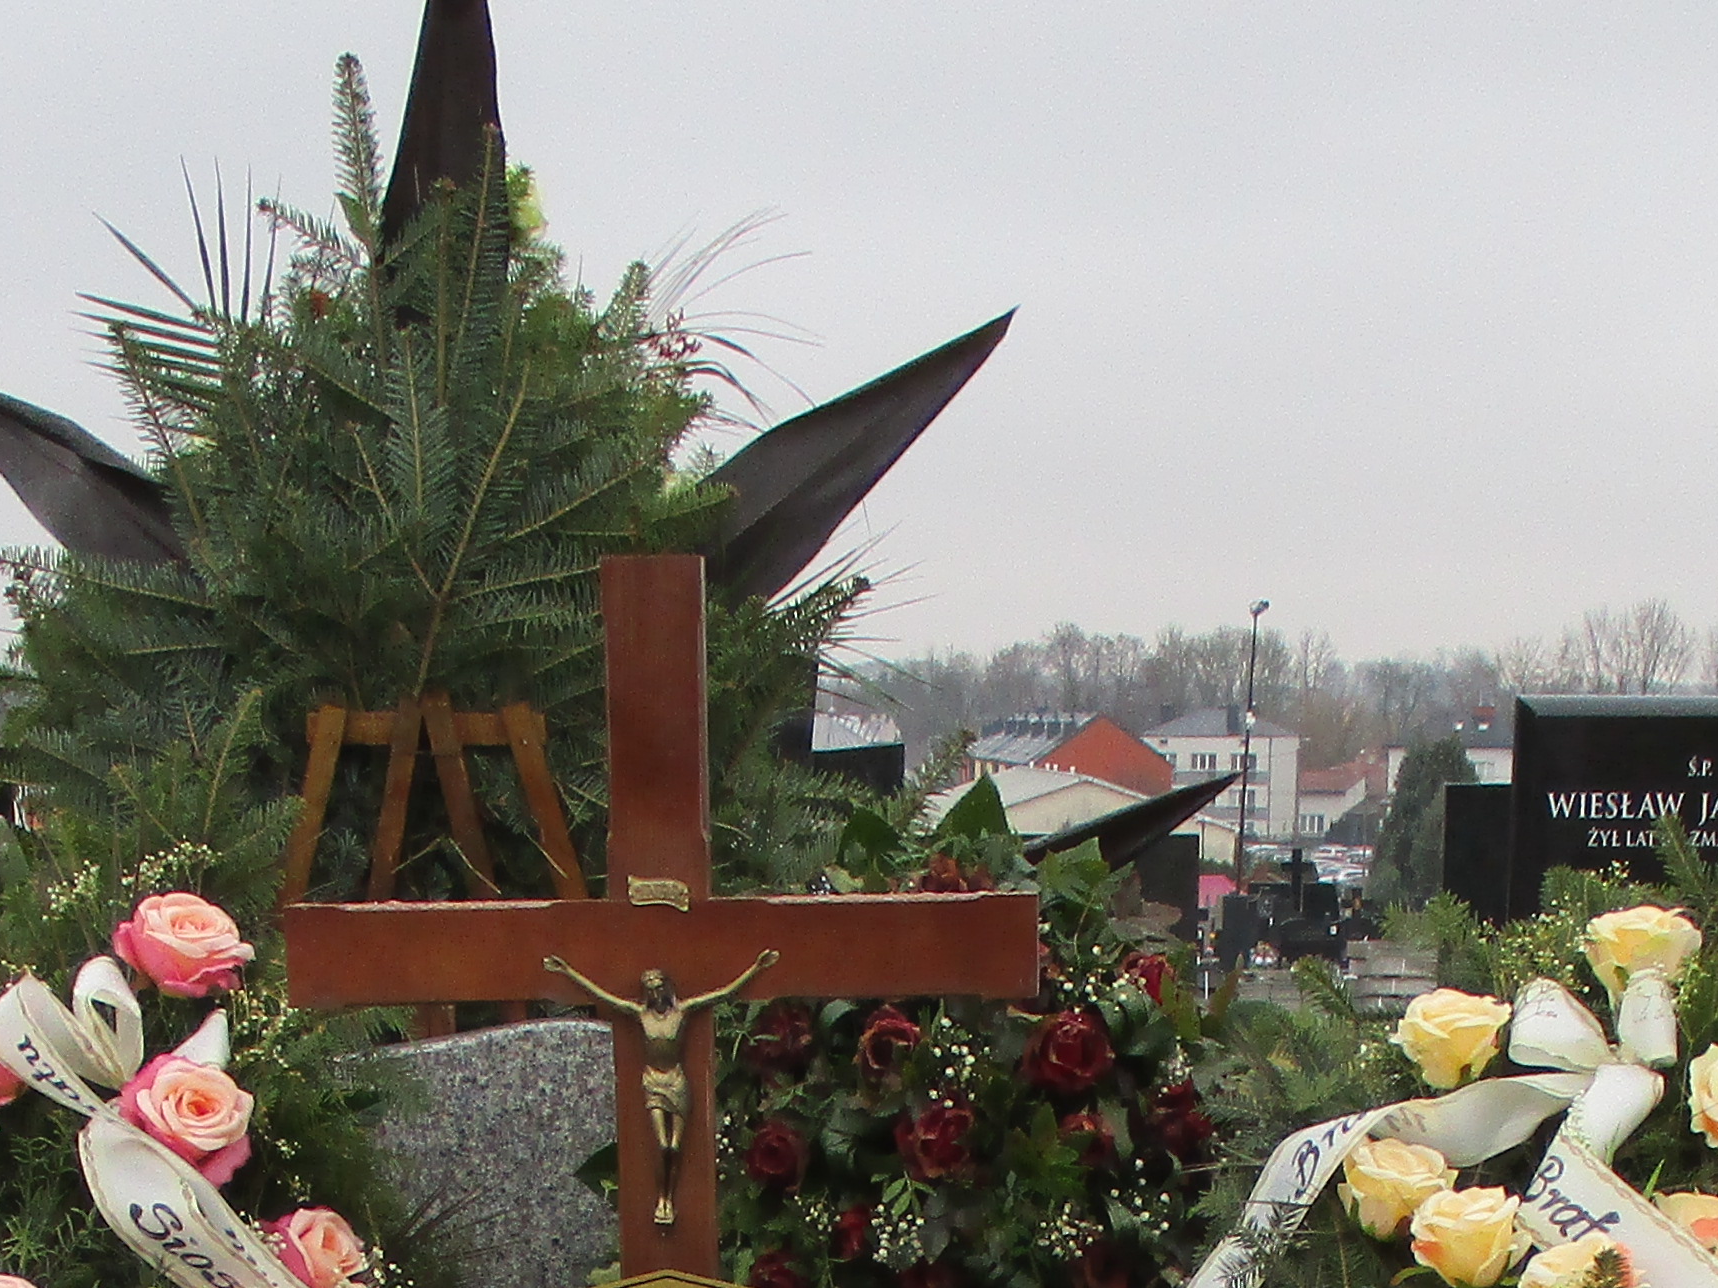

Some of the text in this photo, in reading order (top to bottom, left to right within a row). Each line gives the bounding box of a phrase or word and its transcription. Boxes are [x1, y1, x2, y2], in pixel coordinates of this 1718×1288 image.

[1688, 756, 1713, 777] Ś.P.
[1546, 791, 1685, 820] WIESŁAW
[1588, 827, 1621, 848] ŻYŁ
[1626, 829, 1656, 848] LAT
[1523, 1154, 1621, 1240] Brat
